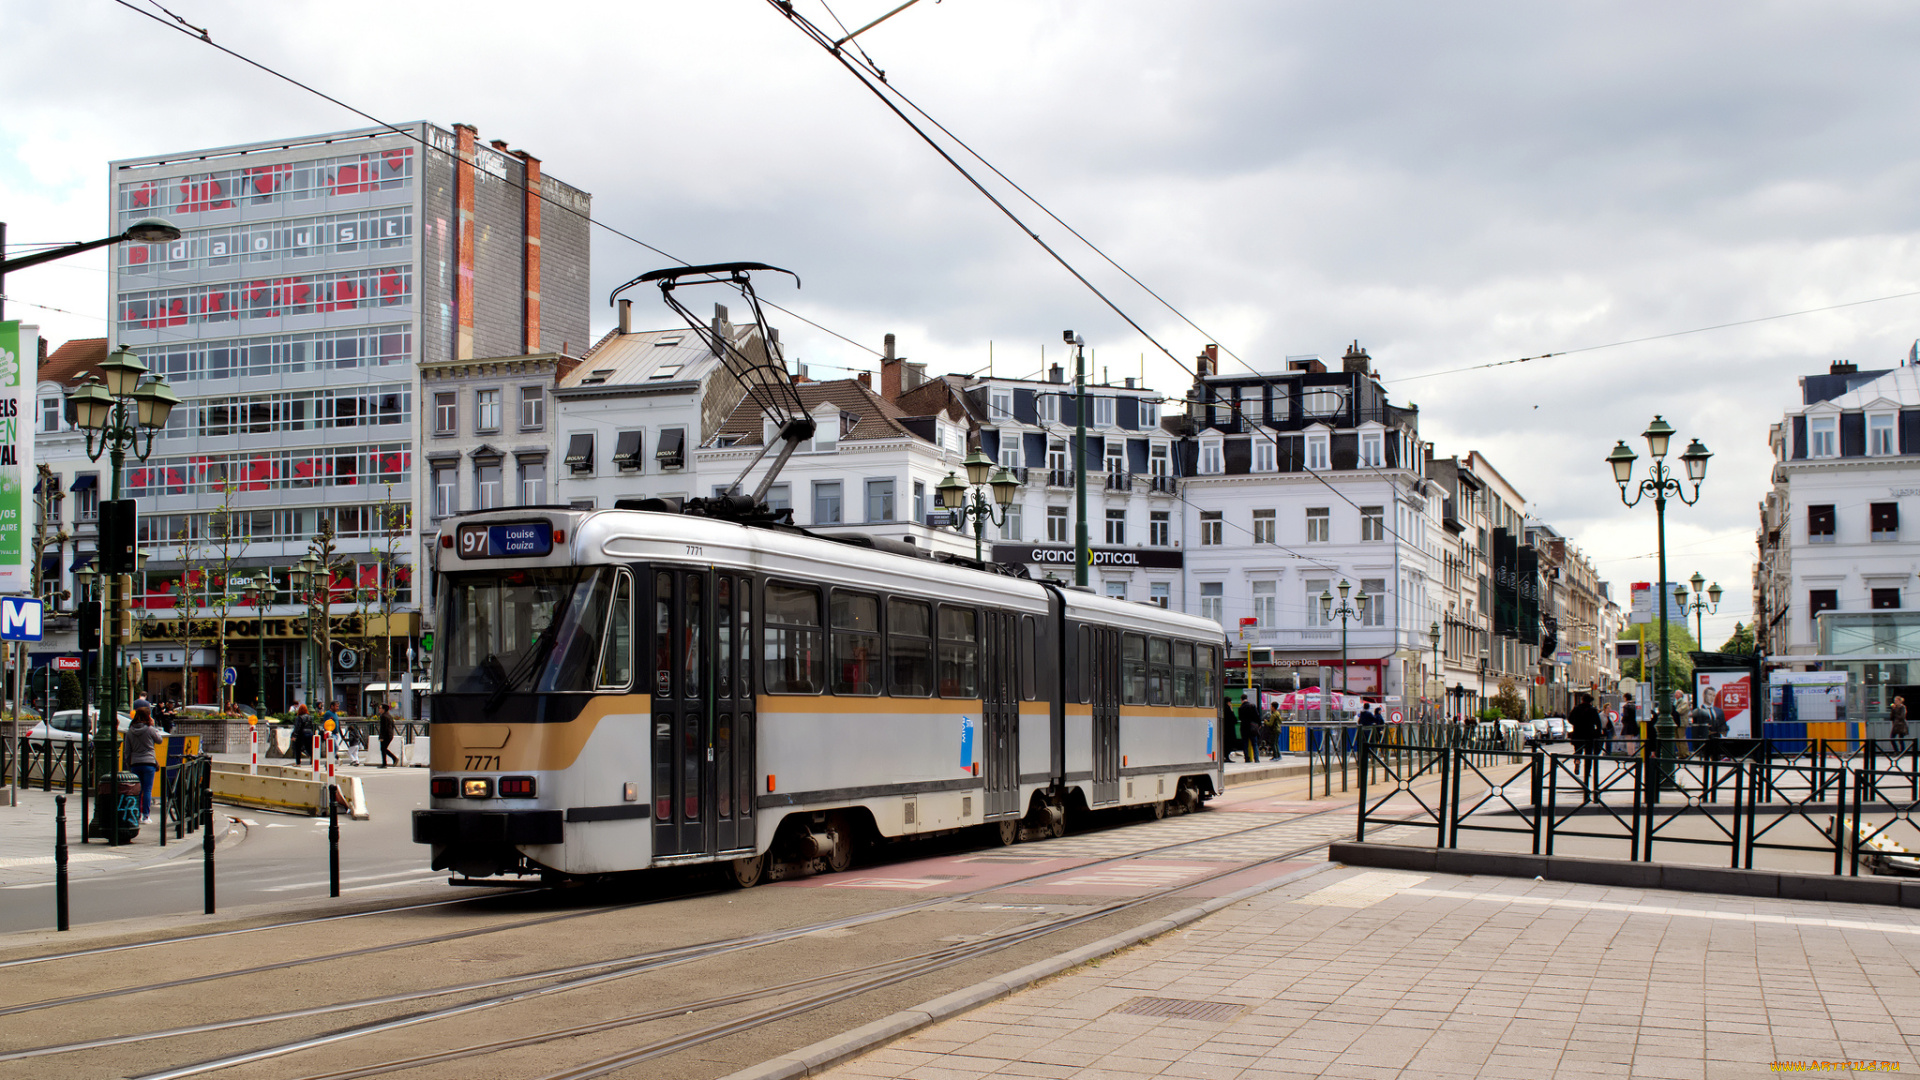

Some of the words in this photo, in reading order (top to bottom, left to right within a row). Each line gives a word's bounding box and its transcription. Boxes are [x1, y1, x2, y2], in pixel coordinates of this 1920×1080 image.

[463, 531, 488, 552] 97
[506, 530, 535, 540] Louise
[506, 541, 534, 550] Louiza
[685, 545, 703, 556] 7771
[2, 600, 41, 636] M
[224, 619, 287, 637] PORTE
[60, 660, 80, 668] Knack
[464, 755, 501, 771] 7771
